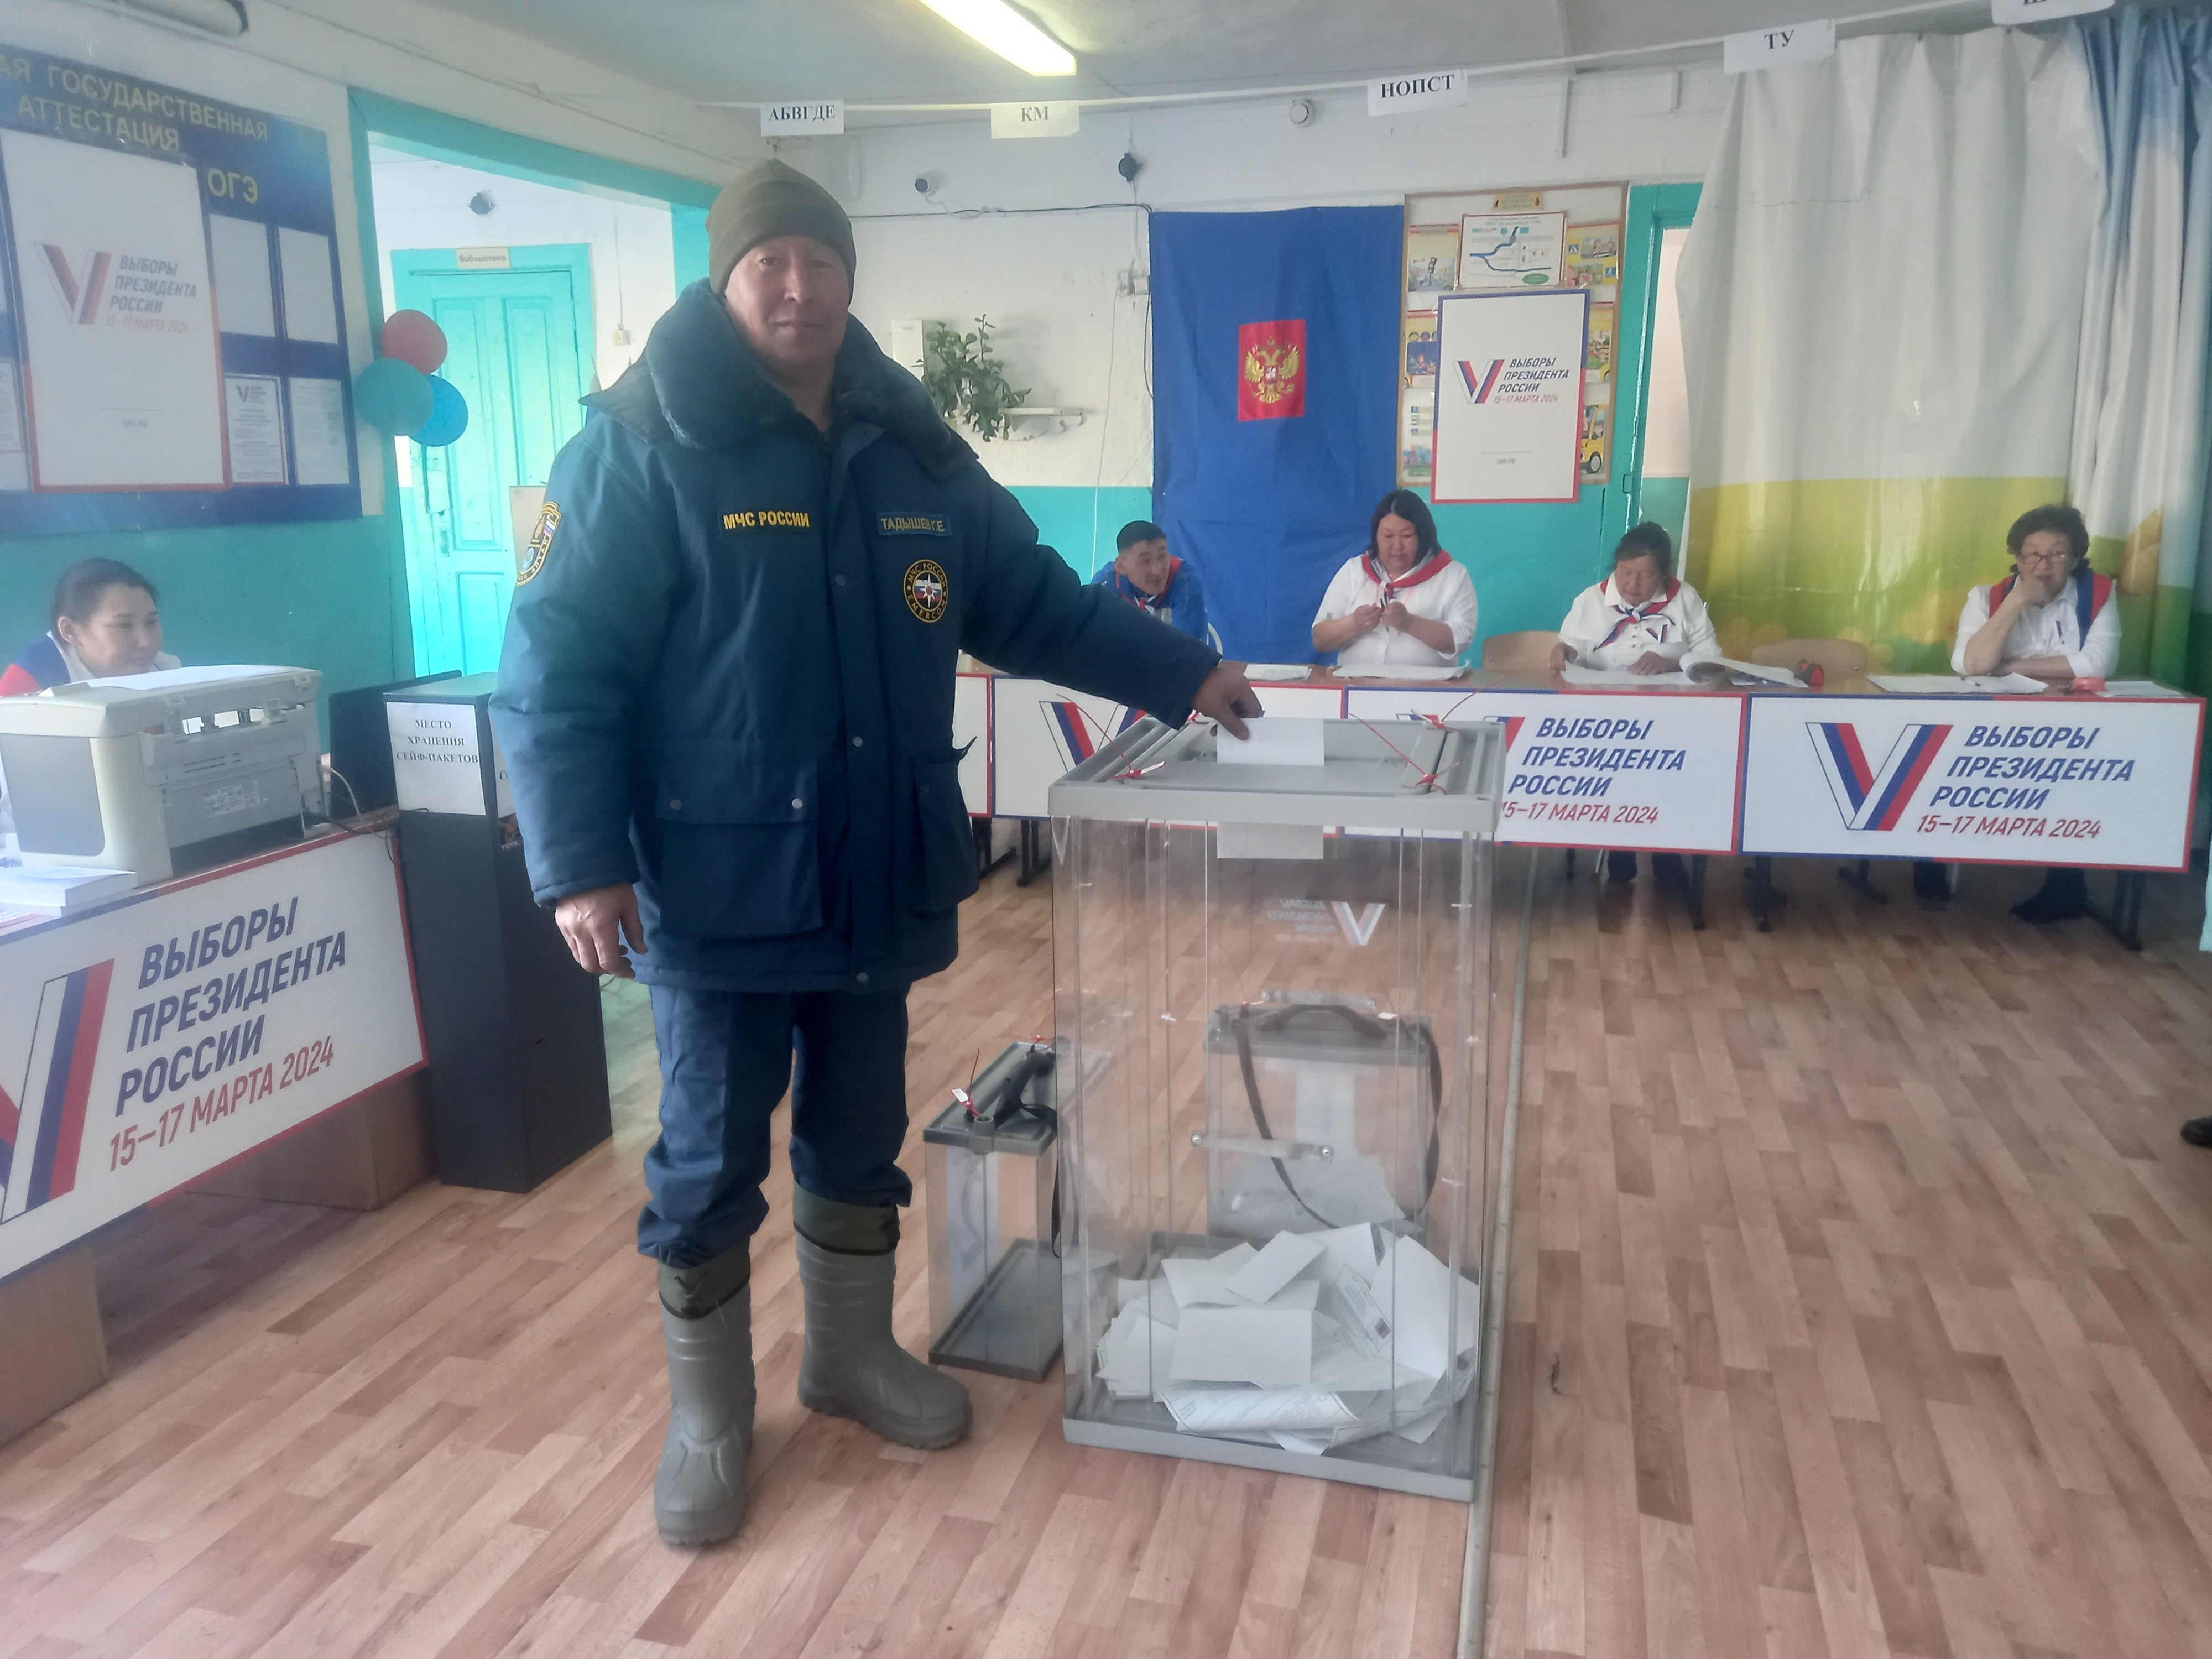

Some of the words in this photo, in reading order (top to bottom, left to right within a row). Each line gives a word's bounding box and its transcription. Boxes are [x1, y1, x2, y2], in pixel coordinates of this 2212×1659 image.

[1764, 29, 1794, 49] ТУ
[1382, 74, 1454, 98] НОПСТ
[48, 65, 269, 142] ГОСУДАРСТВЕННАЯ
[769, 105, 835, 122] АБВГДЕ
[1020, 106, 1048, 122] КМ
[18, 93, 180, 152] АТТЕСТАЦИЯ
[207, 168, 259, 204] ОГЭ
[120, 255, 178, 276] ВЫБОРЫ
[114, 275, 196, 298] ПРЕЗИДЕНТА
[109, 295, 164, 314] РОССИИ
[1510, 357, 1556, 368] ВЫБОРЫ
[1504, 369, 1569, 380] ПРЕЗИДЕНТА
[1498, 383, 1540, 393] РОССИИ
[1514, 395, 1540, 403] МАРТА
[1540, 394, 1558, 403] 2024
[723, 511, 755, 529] МЧС
[758, 510, 810, 527] РОССИИ
[908, 565, 921, 583] МЧС
[922, 562, 946, 587] РОССИИ
[907, 594, 946, 619] EMERCOM
[415, 719, 452, 729] МЕСТО
[1536, 717, 1654, 740] ВЫБОРЫ
[408, 736, 465, 746] ХРАНЕНИЯ
[1964, 726, 2100, 749] ВЫБОРЫ
[396, 750, 478, 763] СЕЙФ-ПАКЕТОВ
[1522, 746, 1686, 771] ПРЕЗИДЕНТА
[1947, 756, 2135, 782] ПРЕЗИДЕНТА
[1508, 774, 1613, 797] РОССИИ
[1929, 786, 2050, 810] РОССИИ
[1548, 803, 1611, 822] МАРТА
[1613, 805, 1658, 824] 2024
[1974, 816, 2047, 836] МАРТА
[2048, 818, 2101, 838] 2024
[138, 896, 299, 990] ВЫБОРЫ
[126, 931, 346, 1053] ПРЕЗИДЕНТА
[116, 1014, 265, 1117] РОССИИ
[190, 1063, 273, 1133] МАРТА
[279, 1035, 333, 1089] 2024
